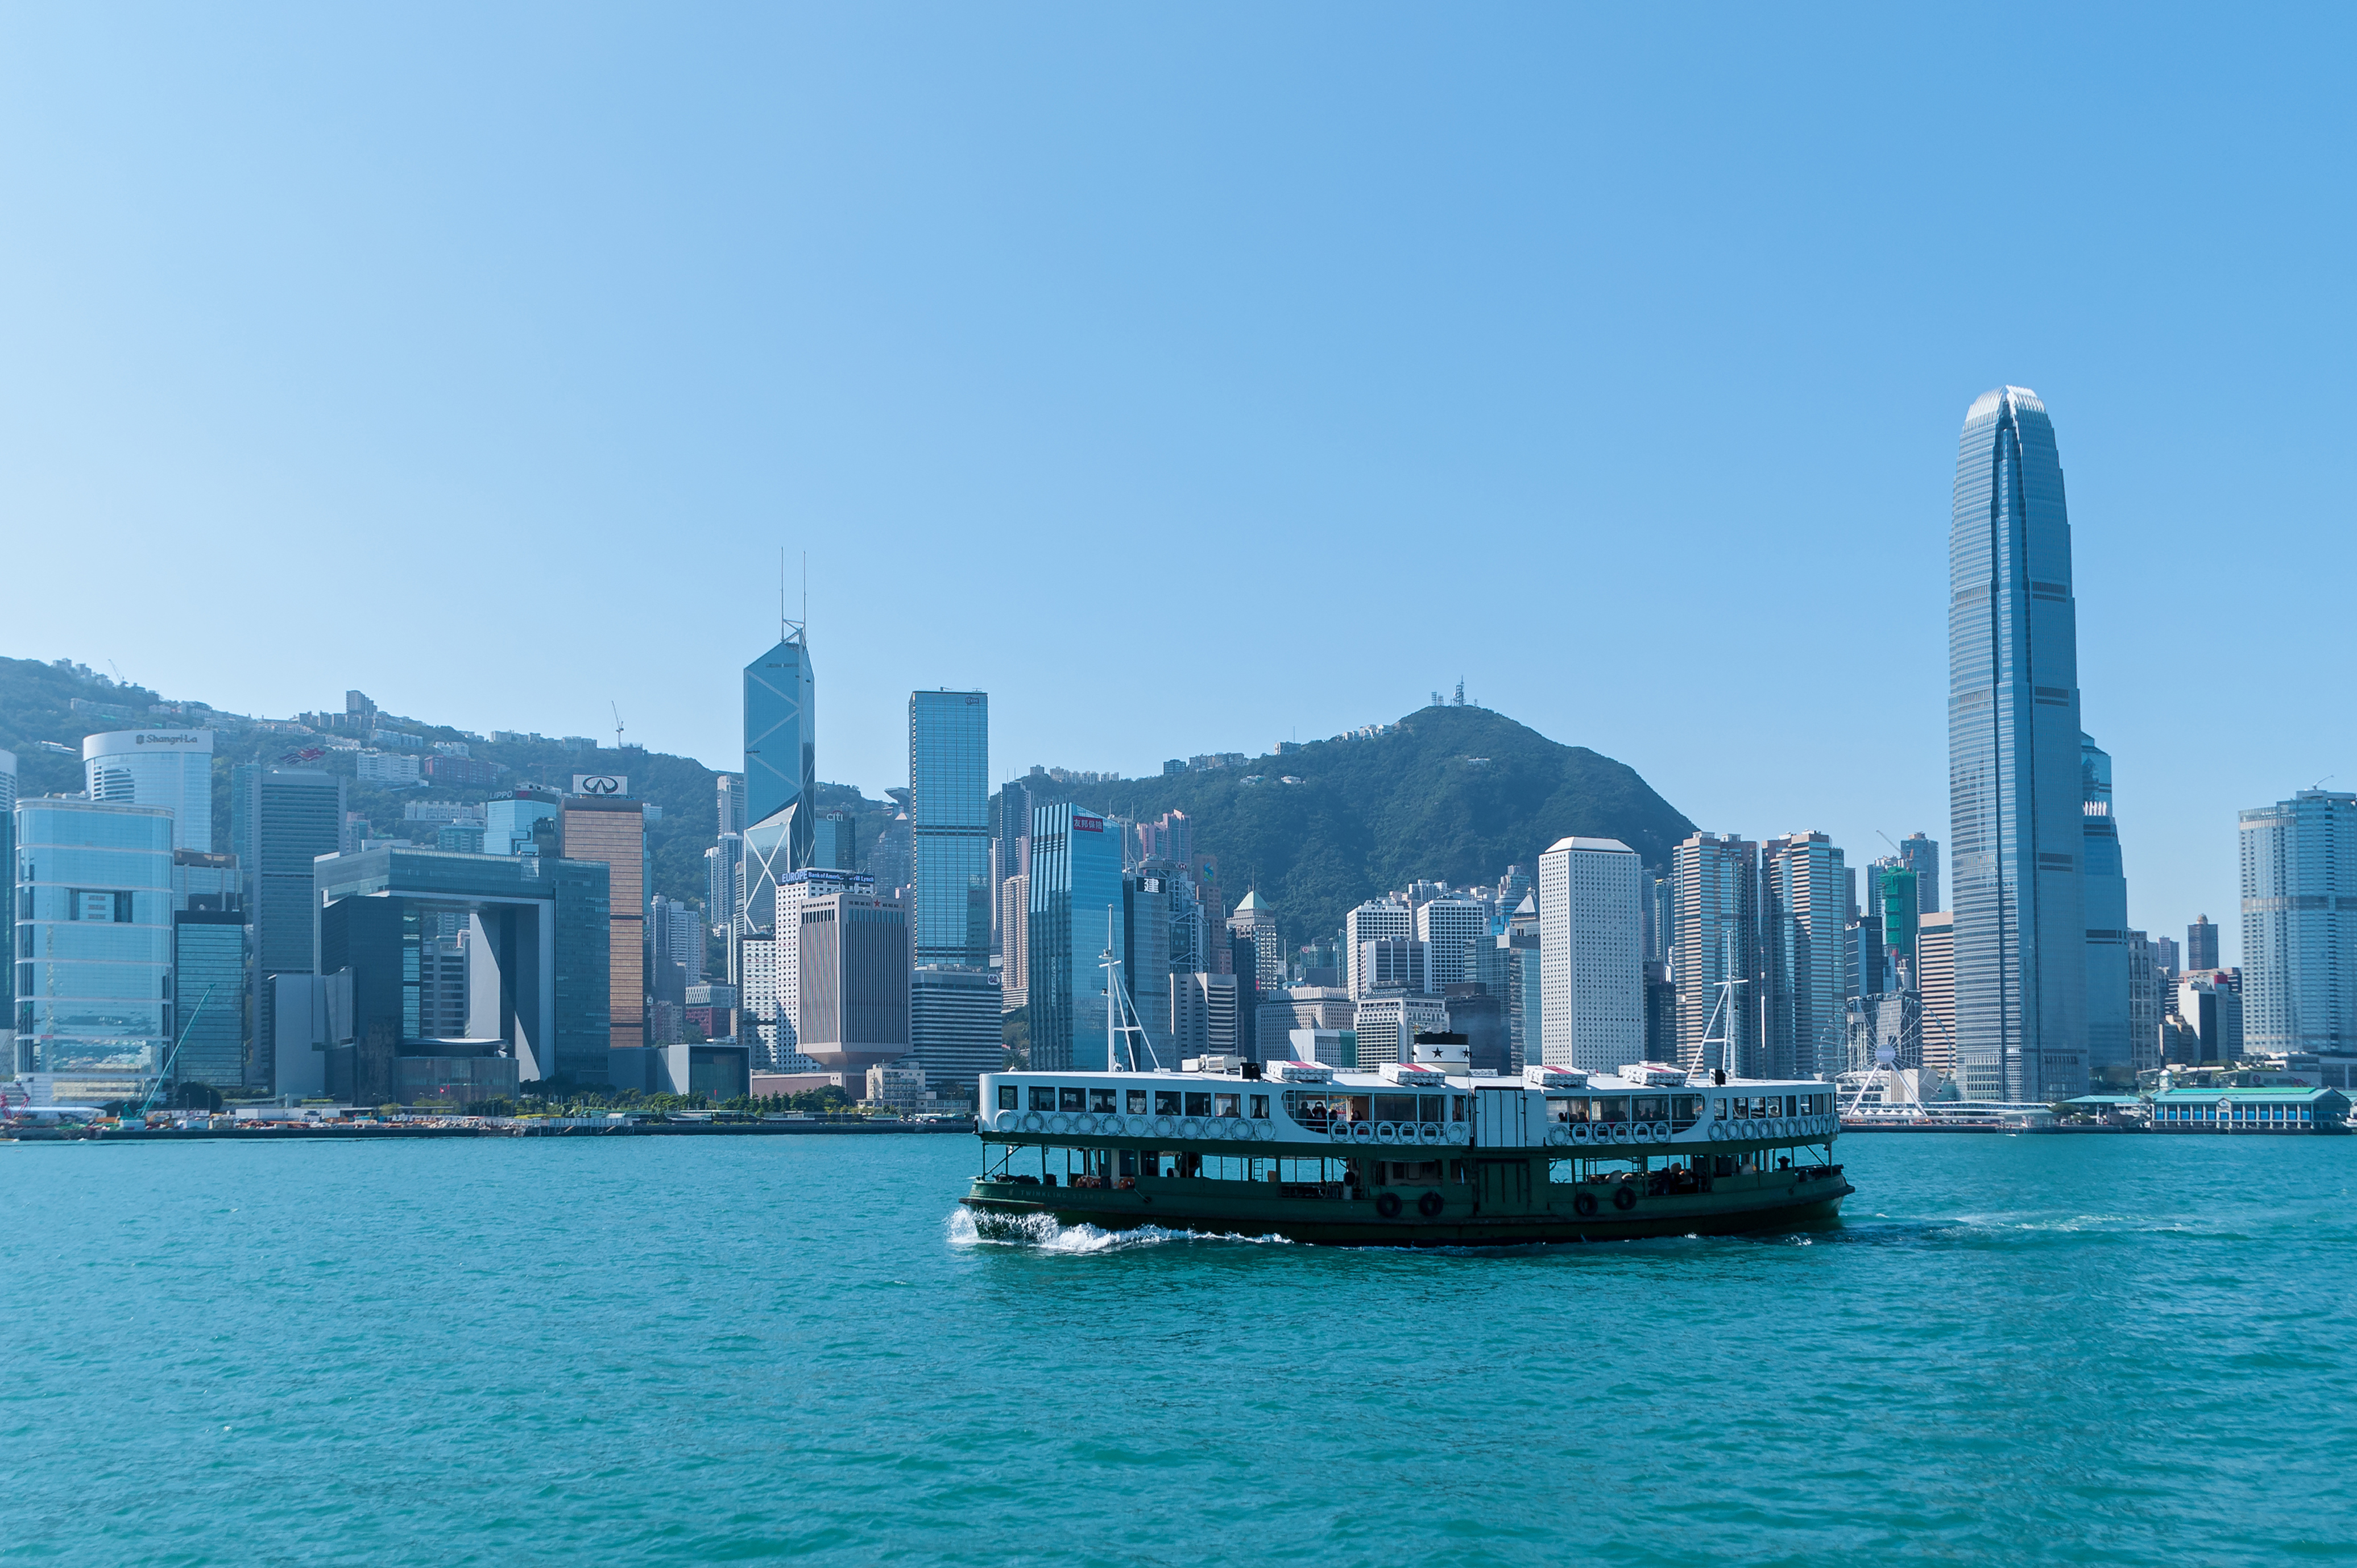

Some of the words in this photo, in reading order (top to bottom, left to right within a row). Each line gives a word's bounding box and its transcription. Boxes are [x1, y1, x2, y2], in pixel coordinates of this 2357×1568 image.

[490, 790, 513, 799] LIPPO
[826, 812, 843, 822] citi
[782, 870, 808, 883] EUROPE
[1144, 878, 1159, 893] 建
[1021, 1190, 1067, 1198] TWINKLING
